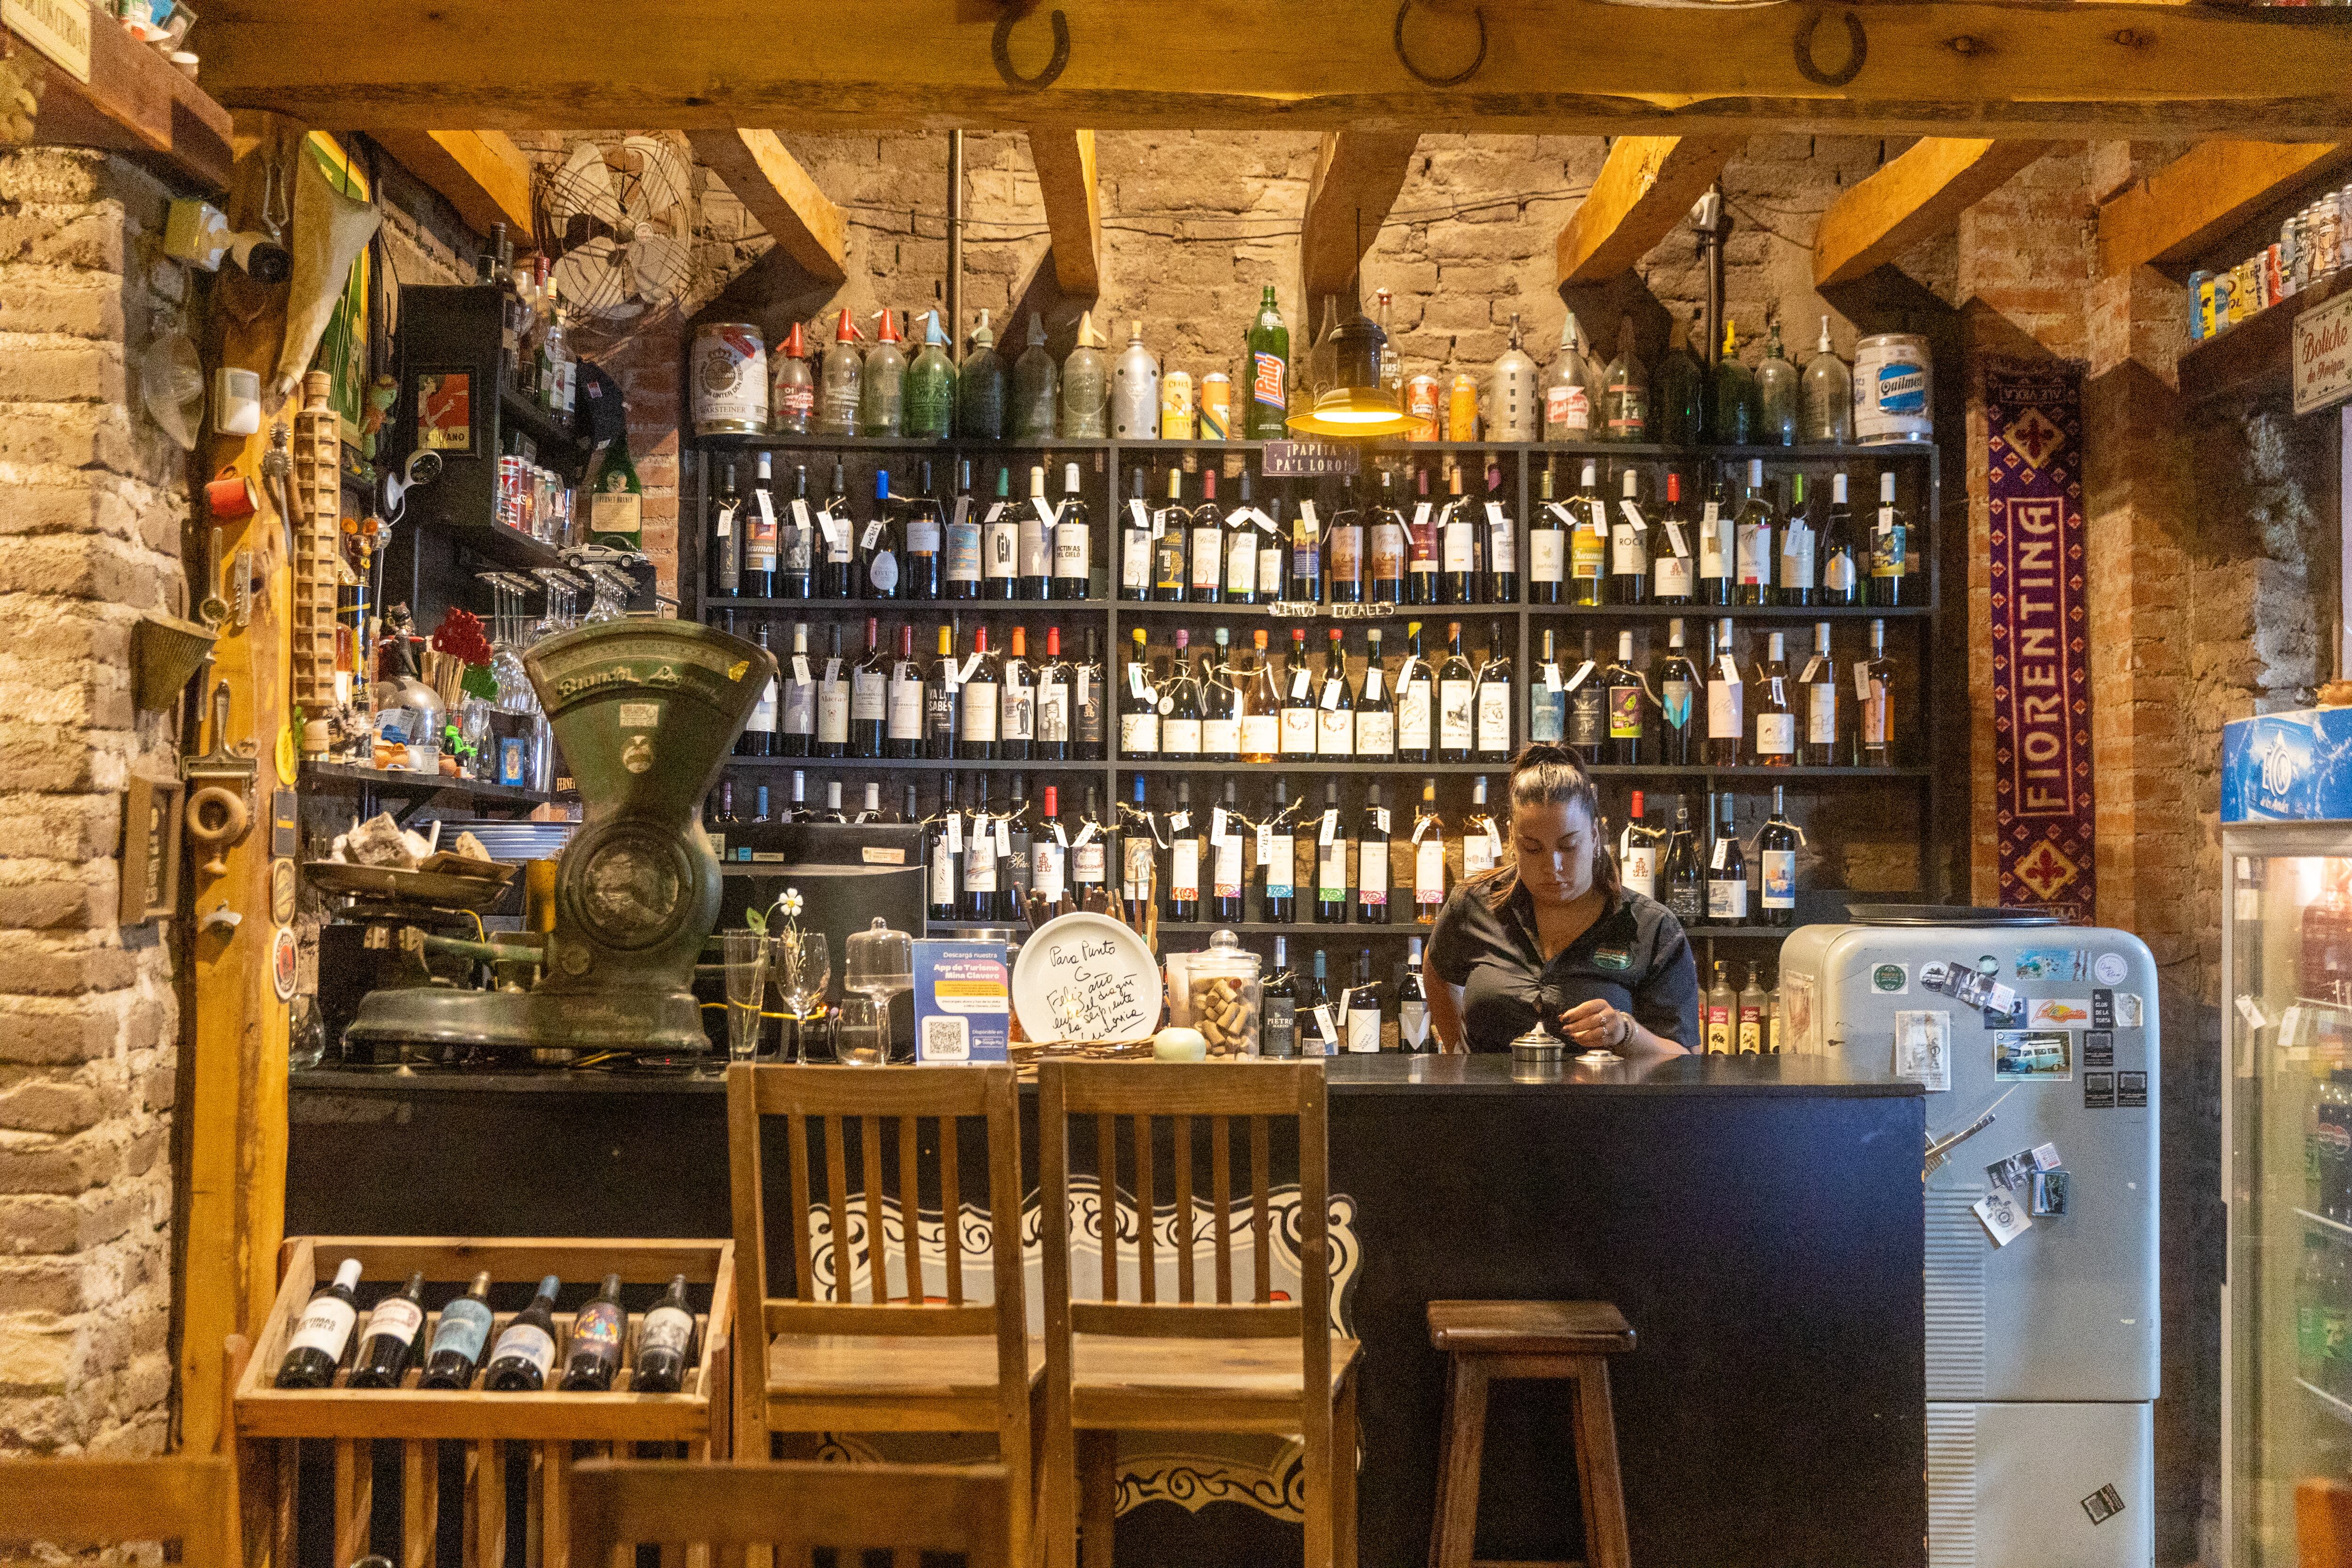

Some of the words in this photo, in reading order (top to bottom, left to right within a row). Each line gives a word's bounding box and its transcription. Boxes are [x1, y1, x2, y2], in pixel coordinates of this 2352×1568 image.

[2303, 319, 2348, 365] Boliche
[1380, 359, 1400, 372] rush
[2018, 502, 2066, 812] FIORENTINA
[943, 952, 972, 961] Descargá
[934, 964, 952, 973] App
